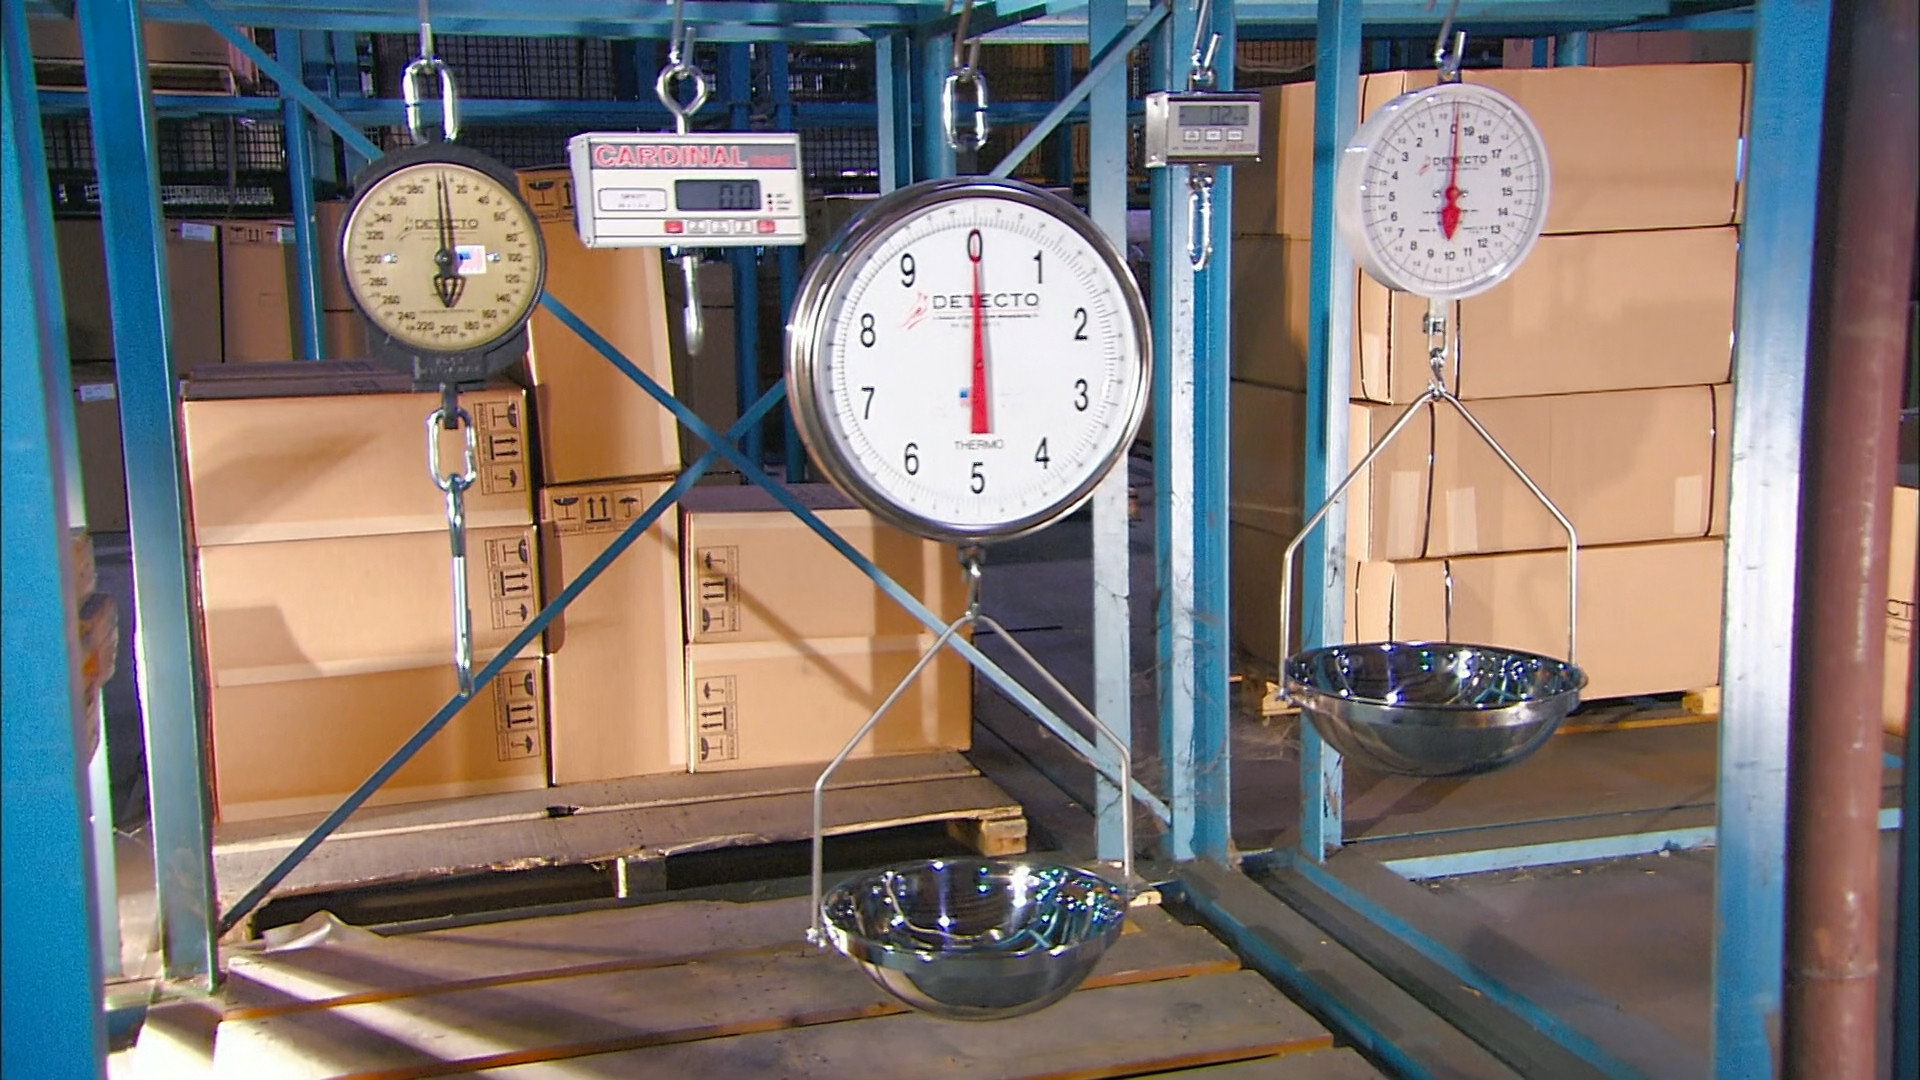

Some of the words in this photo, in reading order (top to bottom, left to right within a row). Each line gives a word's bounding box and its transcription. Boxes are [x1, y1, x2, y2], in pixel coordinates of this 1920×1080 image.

[1434, 128, 1440, 138] 1
[1464, 126, 1475, 136] 19
[1416, 137, 1422, 148] 2
[1478, 134, 1490, 144] 18
[594, 144, 748, 168] CARDINAL
[1402, 152, 1409, 162] 3
[1492, 148, 1502, 158] 17
[1433, 156, 1488, 166] DETECTO
[1392, 172, 1399, 180] 4
[1500, 167, 1512, 177] 16
[456, 185, 468, 194] 20
[1502, 186, 1513, 197] 15
[1388, 192, 1395, 202] 5
[1390, 212, 1398, 222] 6
[1498, 208, 1508, 217] 14
[374, 214, 392, 222] 340
[1398, 228, 1404, 238] 7
[1490, 224, 1501, 234] 13
[967, 228, 982, 262] 0
[1410, 240, 1418, 250] 8
[1478, 238, 1488, 248] 12
[1427, 248, 1434, 258] 9
[1444, 251, 1456, 261] 10
[1464, 247, 1472, 256] 11
[365, 254, 382, 264] 300
[508, 253, 523, 262] 100
[900, 253, 916, 288] 9
[1033, 250, 1043, 284] 1
[505, 274, 520, 284] 120
[932, 292, 1040, 309] DETECTO
[398, 312, 416, 320] 240
[417, 322, 434, 330] 220
[1074, 308, 1088, 340] 2
[440, 325, 458, 334] 200
[860, 313, 876, 348] 8
[1074, 378, 1089, 412] 3
[862, 386, 875, 420] 7
[954, 438, 1004, 450] THERMO
[1034, 437, 1050, 470] 4
[904, 442, 920, 476] 6
[970, 462, 985, 494] 5
